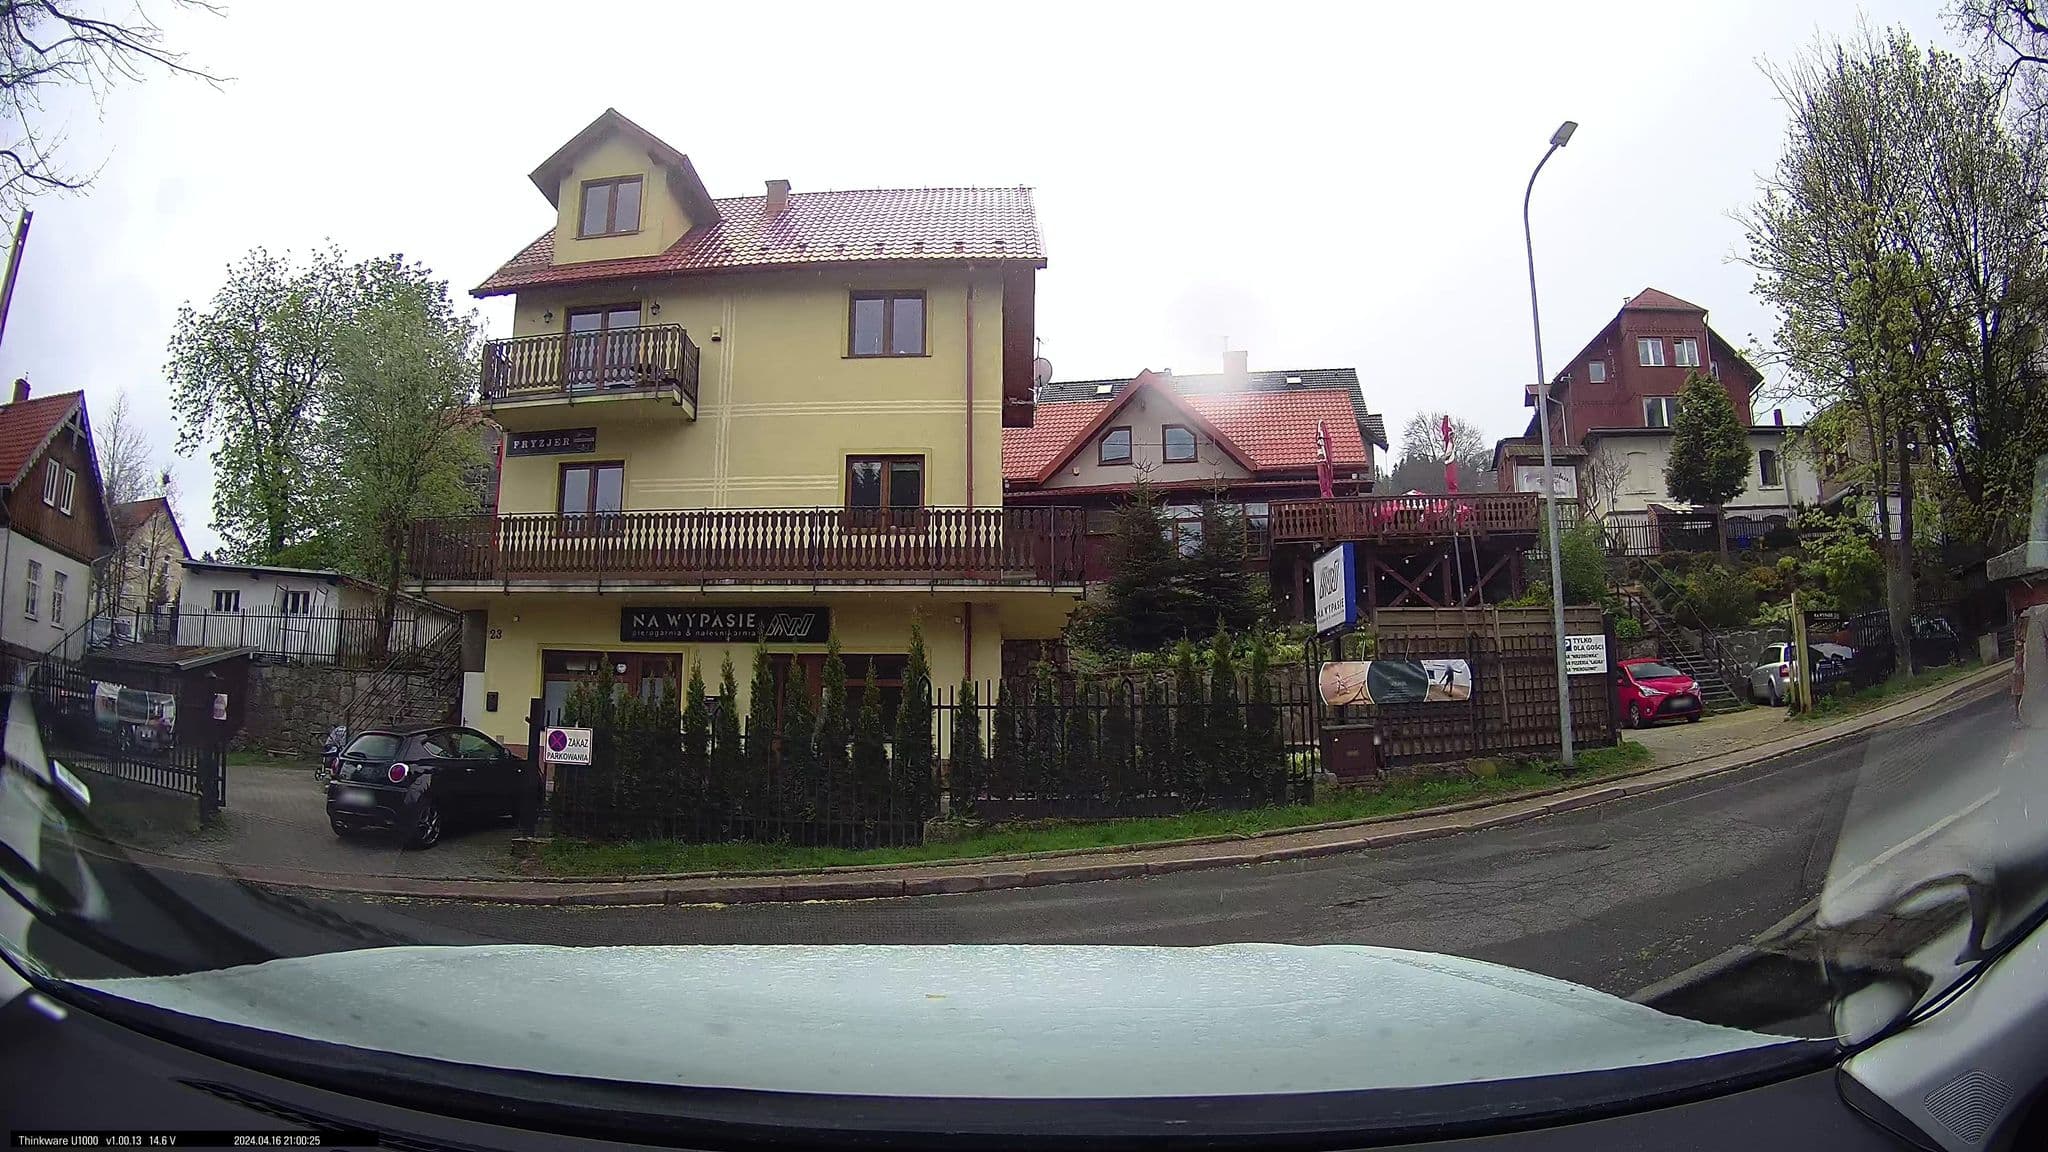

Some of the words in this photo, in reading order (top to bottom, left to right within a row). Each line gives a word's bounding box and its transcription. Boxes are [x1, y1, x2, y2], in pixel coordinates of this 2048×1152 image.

[513, 437, 570, 449] FRYZJER
[632, 613, 659, 628] NA
[666, 613, 756, 628] WYPASIE
[490, 629, 502, 640] 23
[568, 737, 589, 748] ZAKAZ
[546, 751, 588, 761] PARKOWANIA
